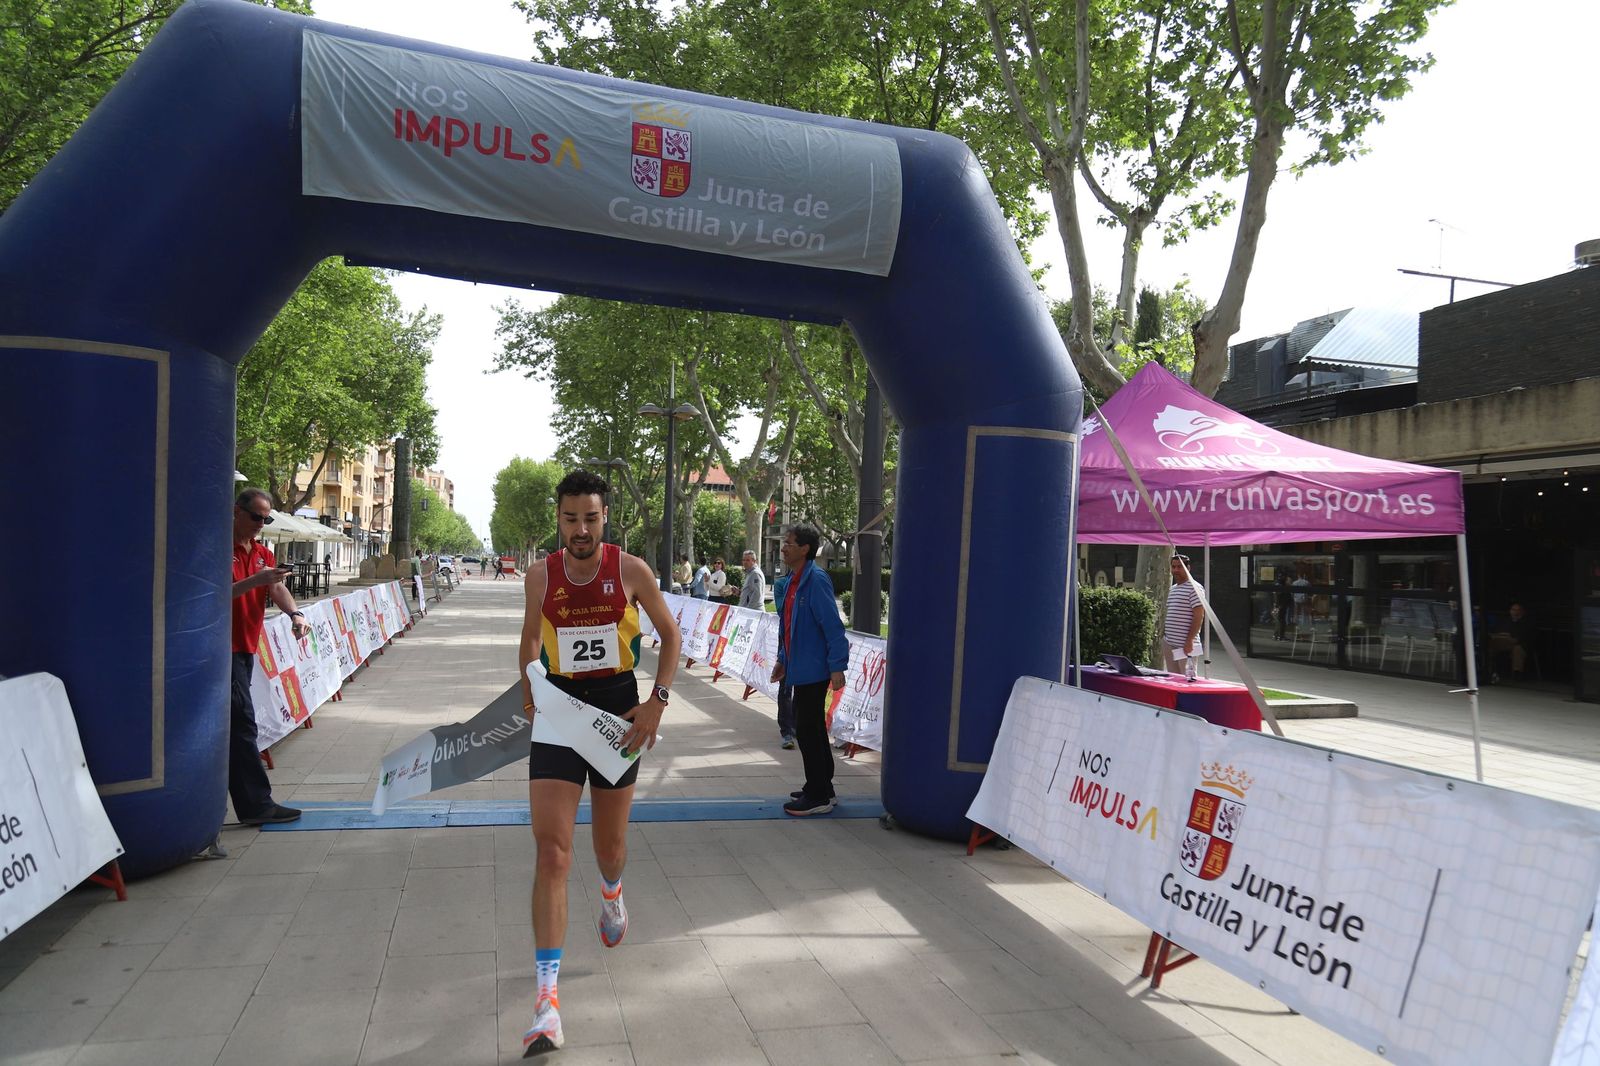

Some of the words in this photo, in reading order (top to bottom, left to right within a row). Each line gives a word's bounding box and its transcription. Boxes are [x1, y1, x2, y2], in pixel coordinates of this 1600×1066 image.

[395, 79, 469, 112] NOS
[698, 177, 785, 213] Junta
[793, 193, 830, 219] de
[608, 196, 721, 236] Castilla
[726, 219, 748, 246] y
[755, 218, 826, 251] León
[1111, 485, 1436, 520] www.runvasport.es
[572, 618, 600, 627] VINO
[590, 605, 614, 614] RURAL
[572, 639, 606, 661] 25
[600, 711, 627, 737] clusión
[434, 738, 456, 763] DÍA
[457, 734, 469, 756] DE
[1079, 748, 1112, 777] NOS
[0, 814, 23, 845] de
[1230, 863, 1316, 922] Junta
[1319, 901, 1364, 942] de
[1160, 872, 1243, 935] Castilla
[1244, 920, 1269, 952] y
[1273, 925, 1353, 989] León
